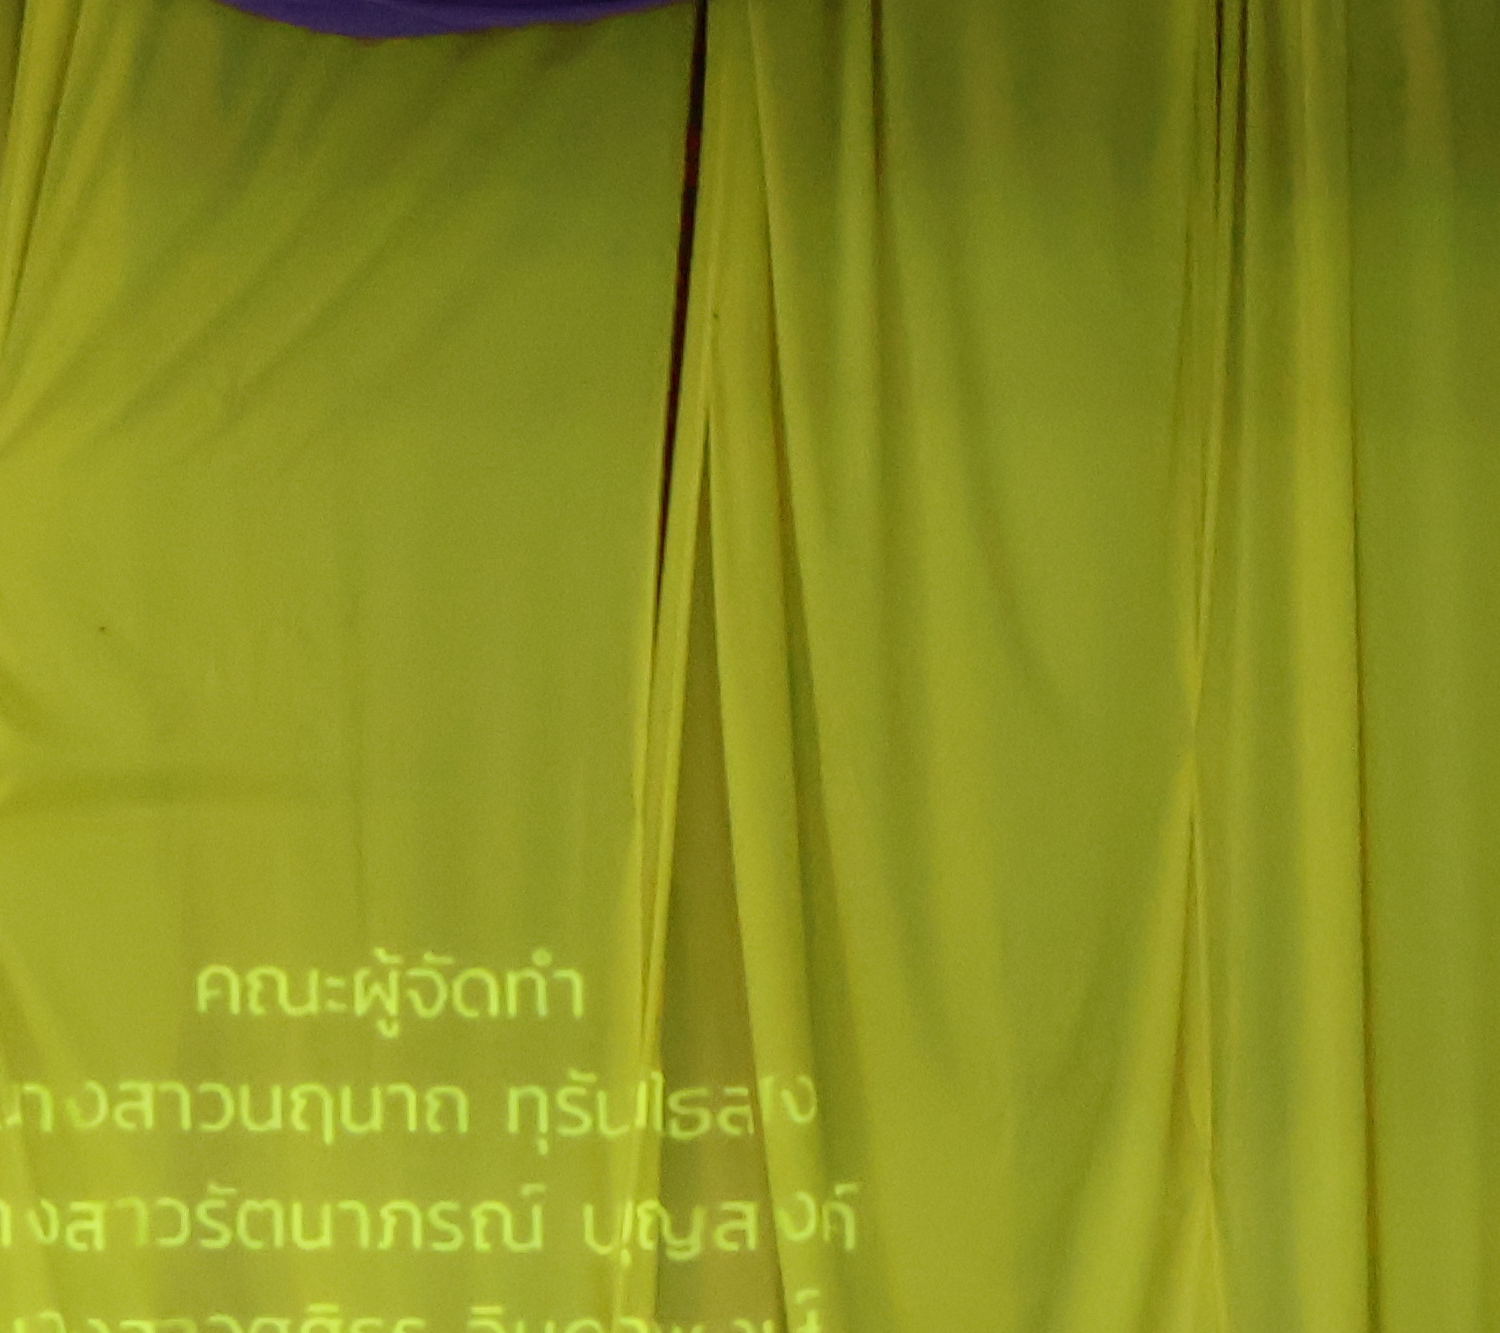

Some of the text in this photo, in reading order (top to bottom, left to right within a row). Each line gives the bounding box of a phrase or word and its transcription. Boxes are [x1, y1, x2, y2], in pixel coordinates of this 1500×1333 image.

[196, 946, 585, 1039] คณะผู้จัดทำ
